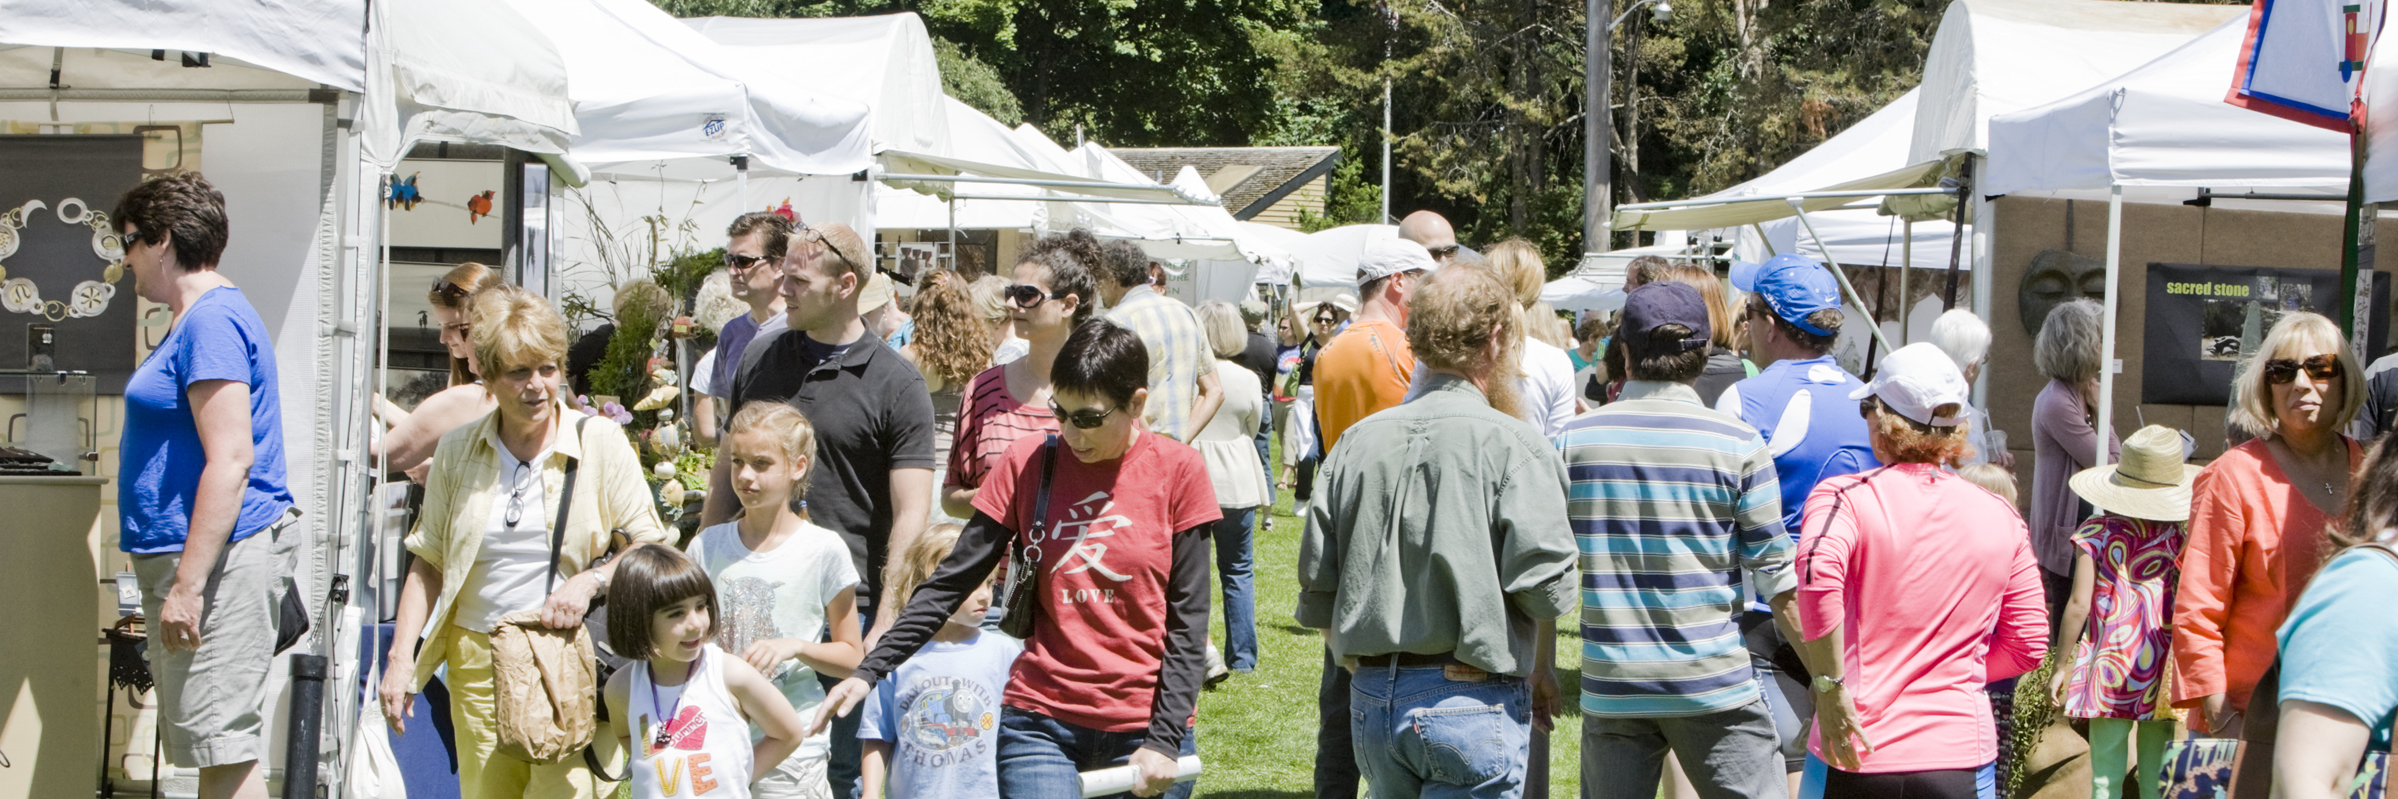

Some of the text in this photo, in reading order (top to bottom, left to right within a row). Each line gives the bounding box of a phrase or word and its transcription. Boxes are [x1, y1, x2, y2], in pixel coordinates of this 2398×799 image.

[2166, 281, 2250, 297] sacred stone
[1050, 490, 1133, 582] 爱
[1062, 589, 1115, 604] LOVE
[899, 676, 992, 711] DAY OUT WITH
